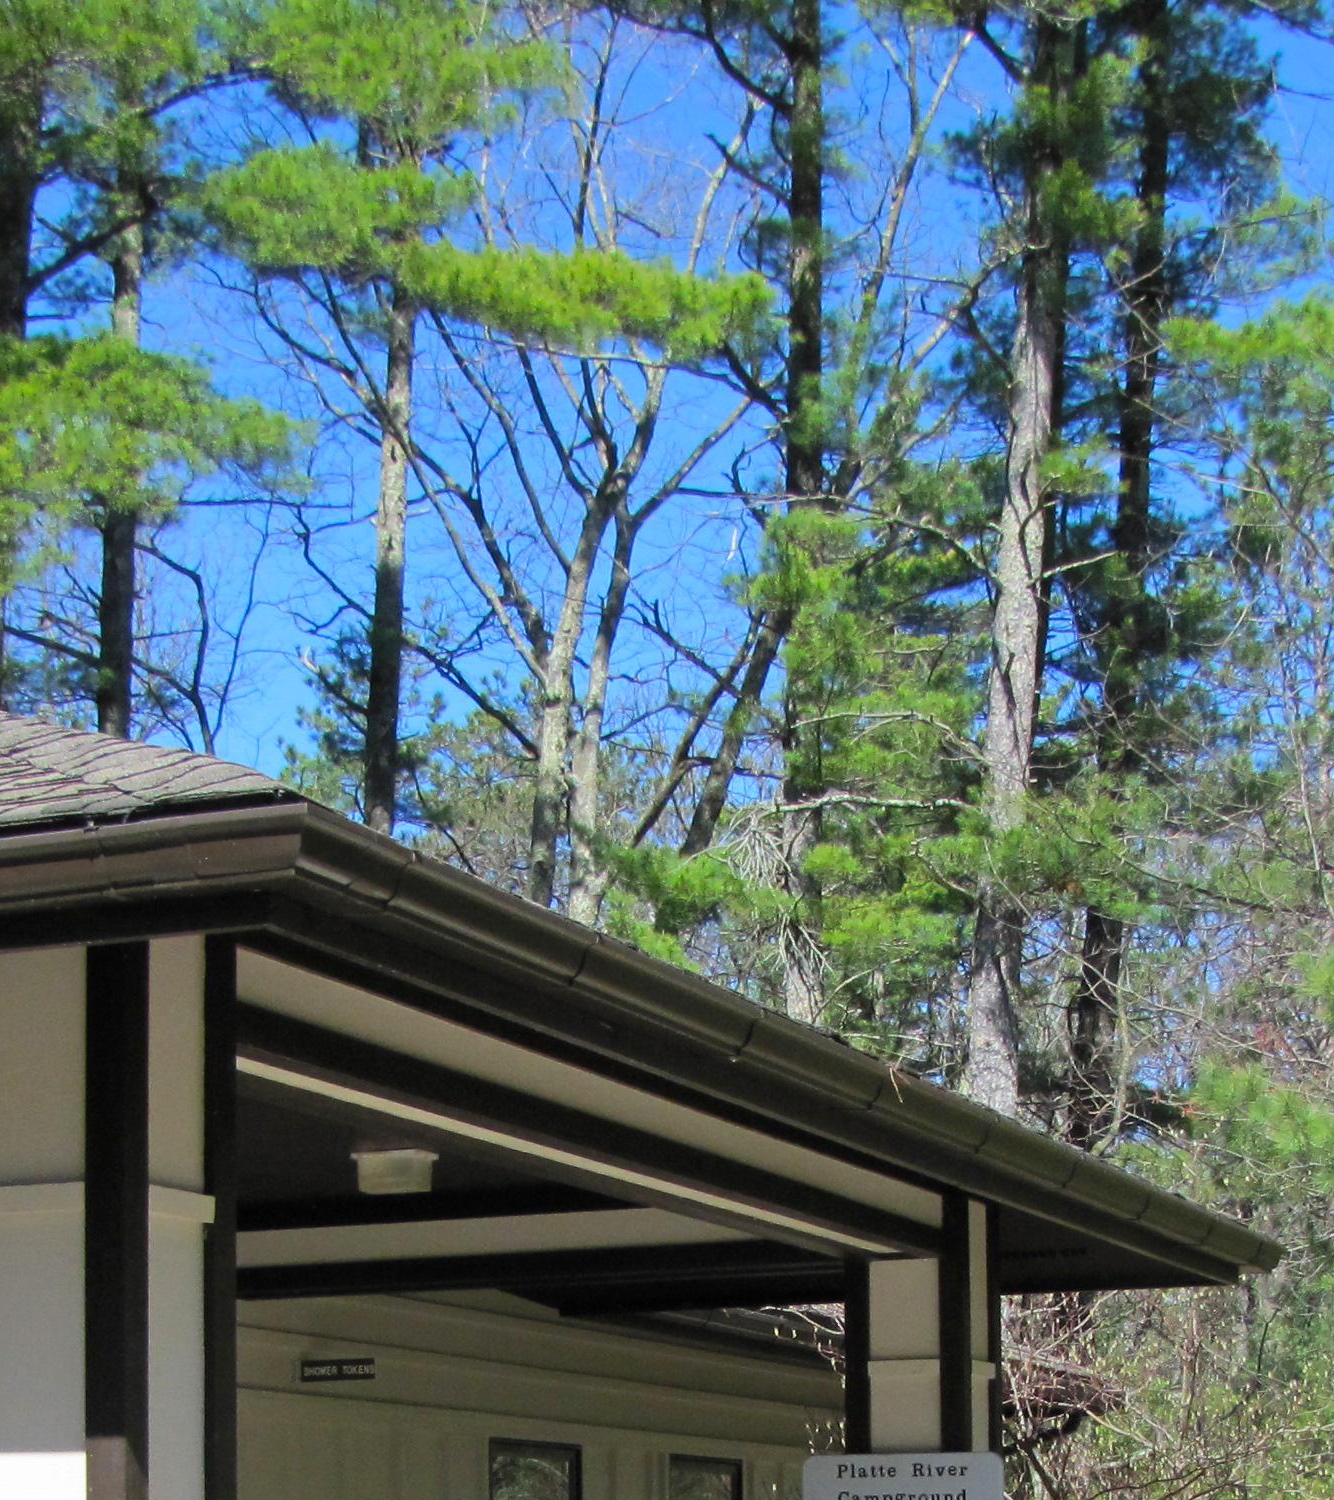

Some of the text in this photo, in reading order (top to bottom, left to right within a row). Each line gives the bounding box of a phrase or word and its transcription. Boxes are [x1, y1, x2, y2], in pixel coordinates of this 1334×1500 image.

[342, 1364, 374, 1375] TOKENS
[836, 1462, 968, 1479] Platte River
